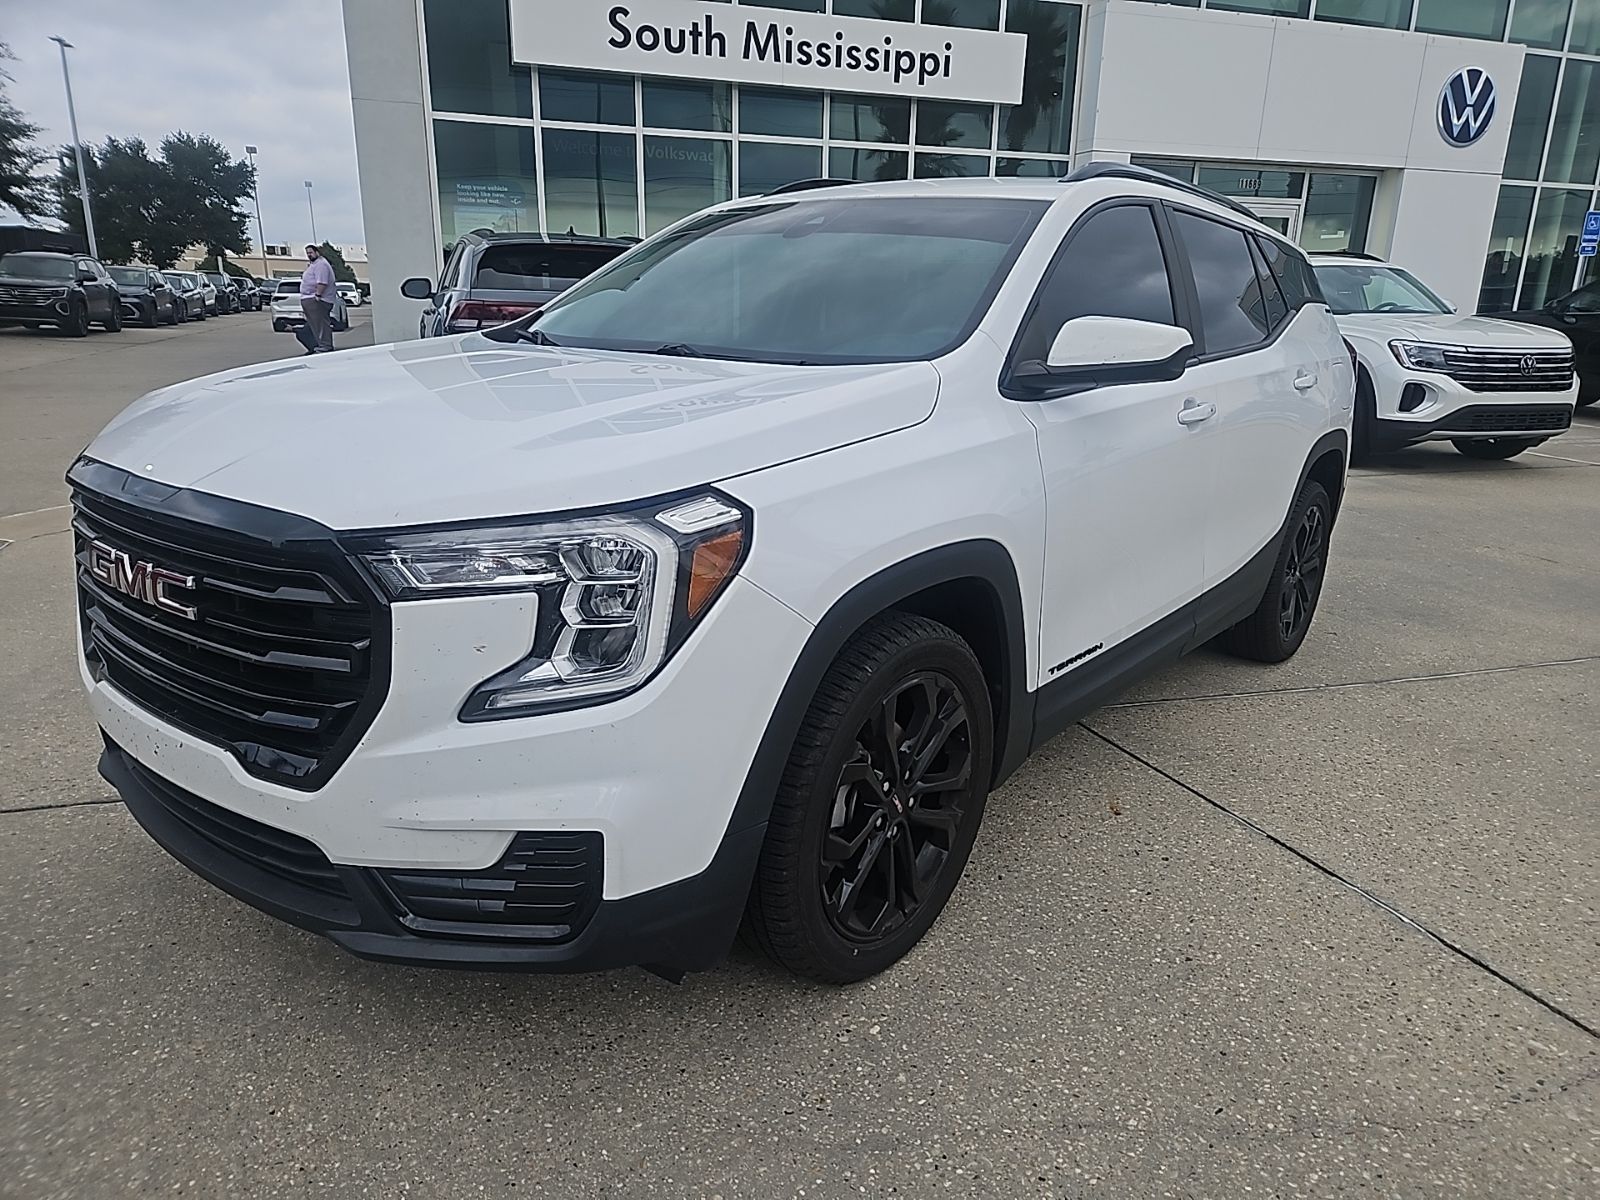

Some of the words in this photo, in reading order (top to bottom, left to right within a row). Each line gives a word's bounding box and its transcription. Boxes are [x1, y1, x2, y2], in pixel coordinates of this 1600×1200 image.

[607, 5, 727, 58] South
[742, 21, 953, 86] Mississippi
[552, 139, 623, 157] Welcome
[86, 540, 197, 620] GMC
[1047, 642, 1104, 676] TERRAIN
